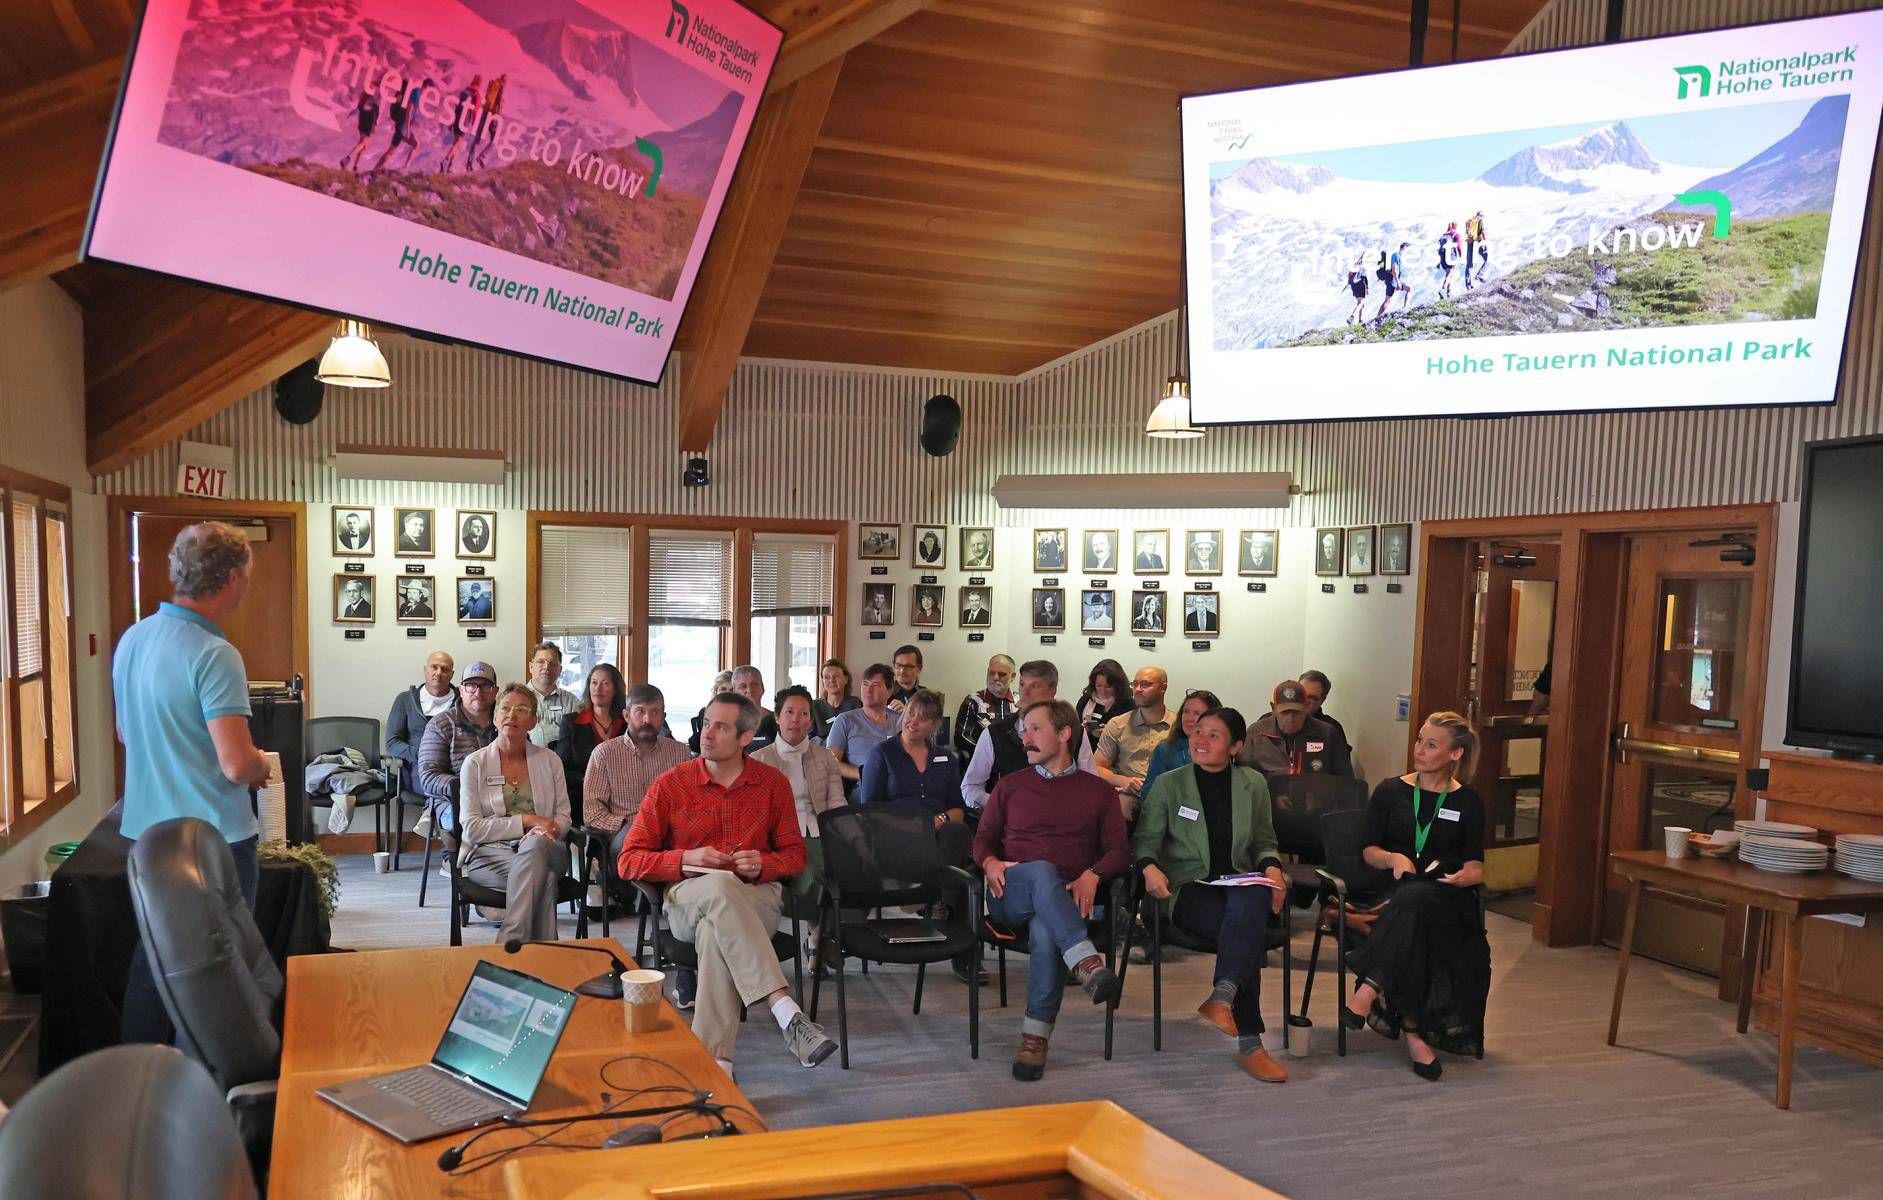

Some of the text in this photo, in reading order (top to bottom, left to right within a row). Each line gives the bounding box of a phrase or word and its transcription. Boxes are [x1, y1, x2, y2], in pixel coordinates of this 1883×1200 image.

[686, 34, 753, 85] Hohe Tauern
[692, 15, 759, 68] Nationalpark
[1719, 46, 1856, 78] Nationalpark
[1716, 68, 1854, 96] Hohe Tauern
[321, 36, 645, 200] Interesting to know
[1533, 230, 1574, 259] to
[1587, 222, 1705, 256] know
[399, 245, 665, 339] Hohe Tauern National Park
[1426, 337, 1814, 375] Hohe Tauern National Park
[184, 465, 228, 497] EXIT
